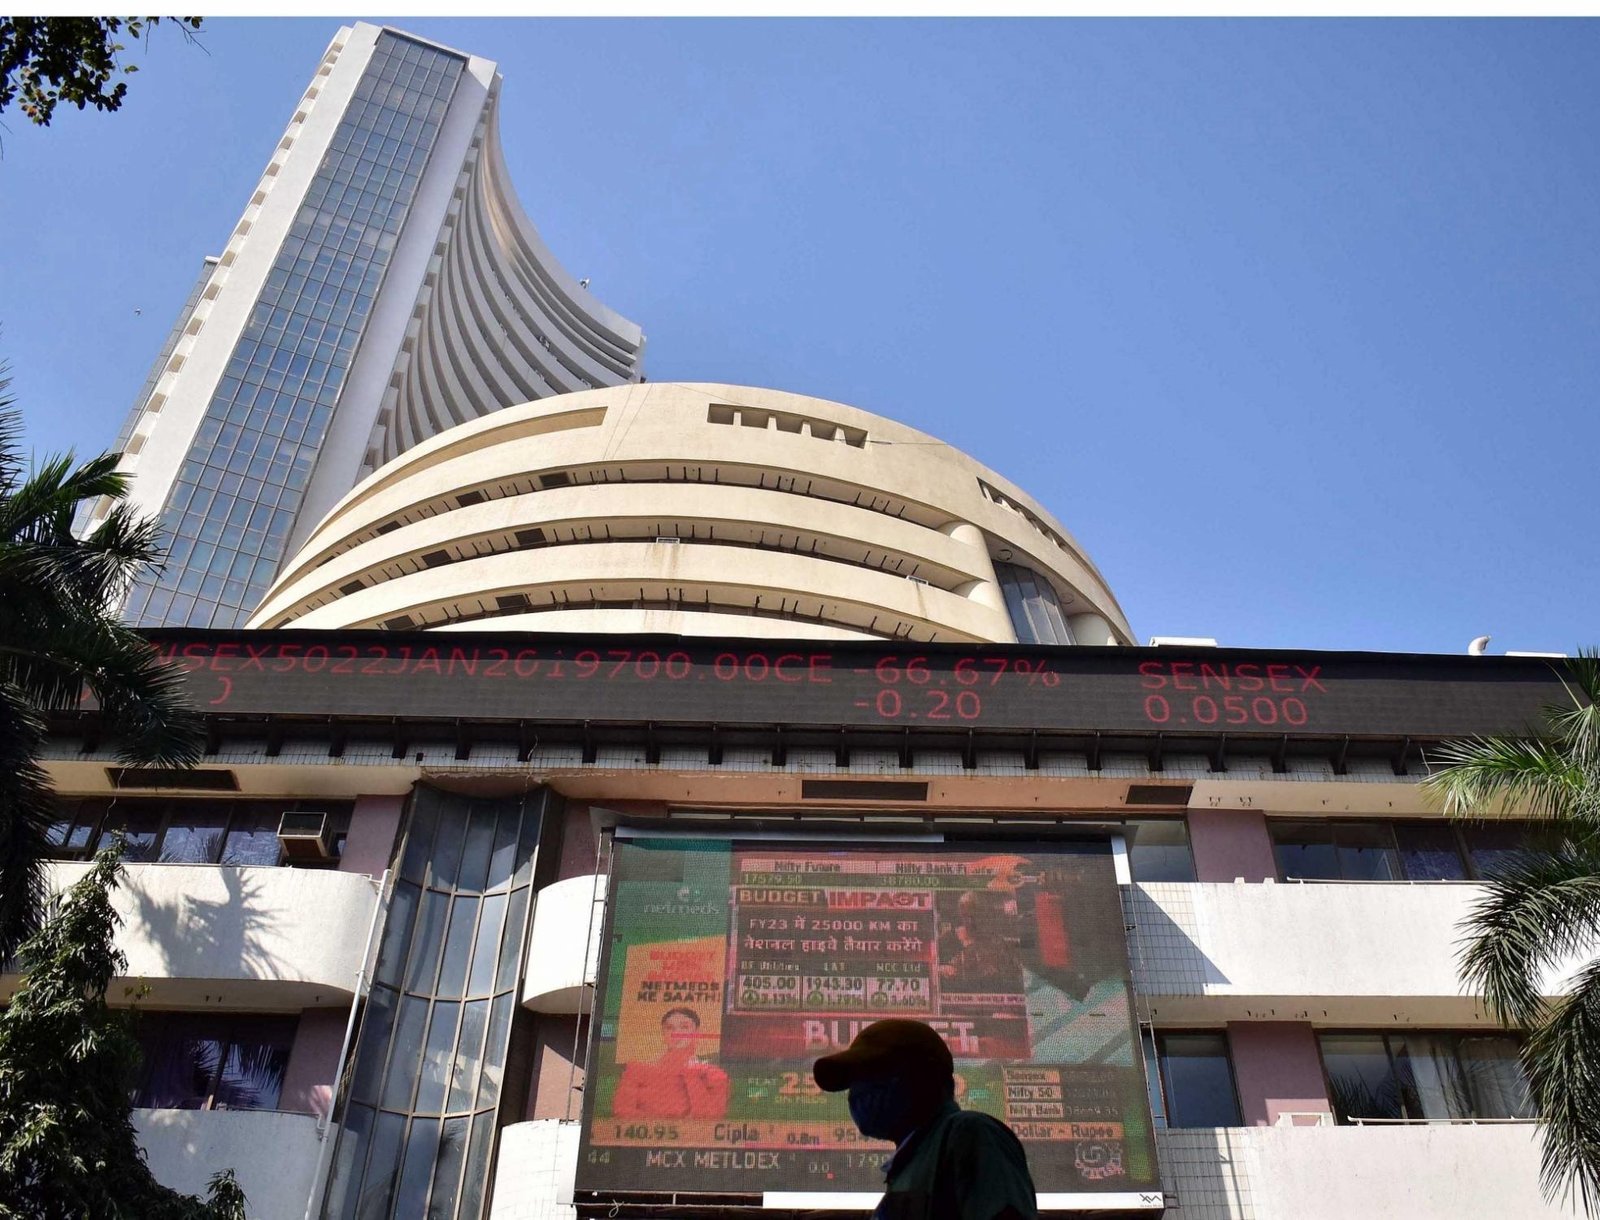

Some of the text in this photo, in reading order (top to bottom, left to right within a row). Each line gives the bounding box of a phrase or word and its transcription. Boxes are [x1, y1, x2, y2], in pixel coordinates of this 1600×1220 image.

[853, 656, 1061, 688] -66.67%
[1138, 662, 1328, 693] SENSEX
[854, 688, 982, 719] -0.20
[1144, 695, 1309, 725] 0.0500
[740, 890, 821, 904] BUDGET
[749, 915, 919, 932] FY23 में 25000 KM का
[641, 980, 720, 991] NETMEDS
[877, 978, 920, 991] 77.70
[615, 1124, 679, 1140] 140.95
[714, 1123, 760, 1144] Cipla
[646, 1150, 780, 1169] MCX METLDEX
